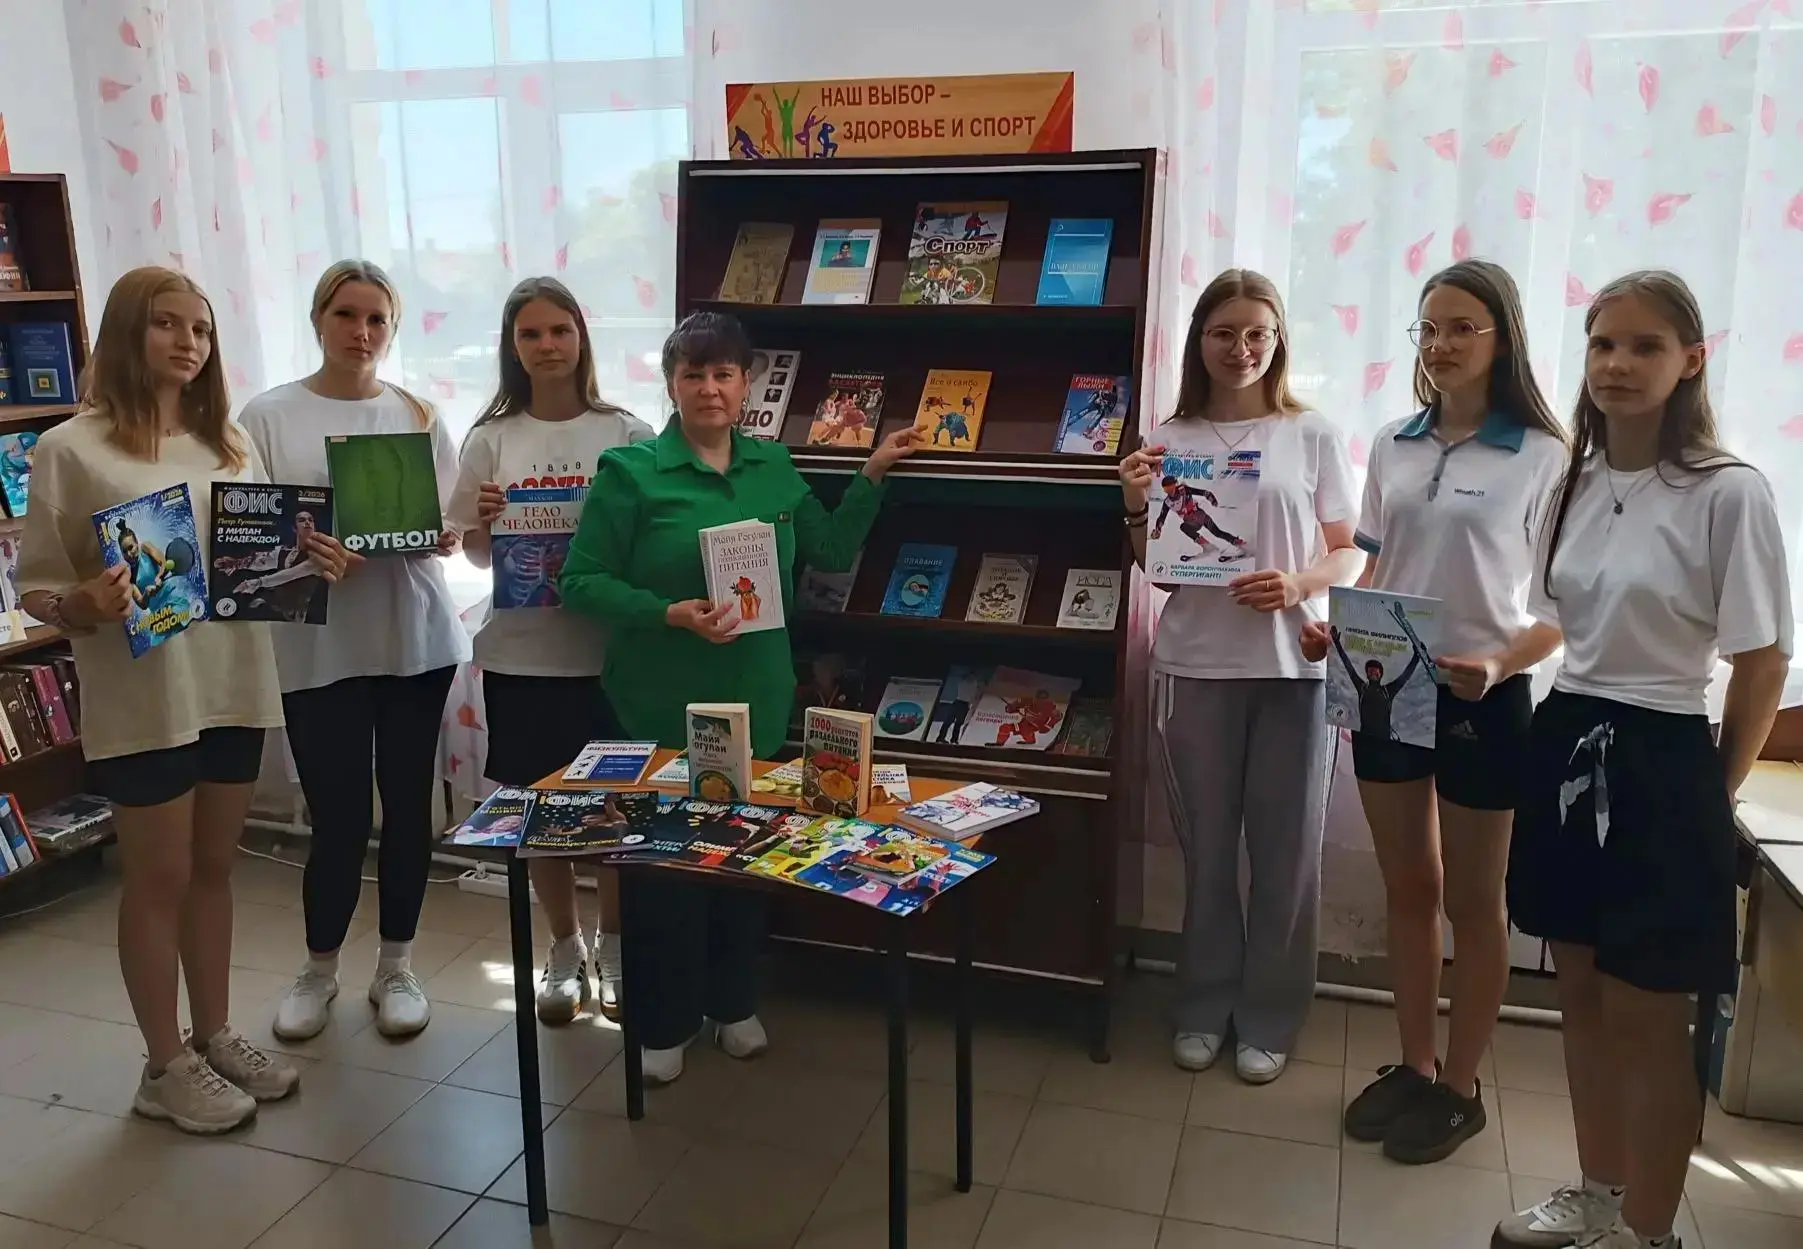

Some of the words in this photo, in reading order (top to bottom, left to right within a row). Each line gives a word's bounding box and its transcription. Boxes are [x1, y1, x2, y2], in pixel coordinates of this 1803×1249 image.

[821, 86, 863, 107] НАШ
[868, 84, 936, 106] ВЫБОР
[843, 119, 945, 142] ЗДОРОВЬЕ
[952, 118, 963, 138] И
[970, 115, 1036, 140] СПОРТ
[925, 236, 990, 255] Спорт
[223, 491, 283, 514] ФИС
[521, 506, 561, 518] ТЕЛО
[217, 527, 224, 535] В
[225, 527, 262, 536] МИЛАН
[503, 518, 579, 531] ЧЕЛОВЕКА
[217, 535, 224, 543] С
[225, 534, 281, 544] НАДЕЖДОЙ
[344, 529, 439, 551] ФУТБОЛ
[720, 543, 765, 557] ЗАКОНЫ
[719, 558, 769, 573] ПИТАНИЯ
[810, 715, 832, 731] 1000
